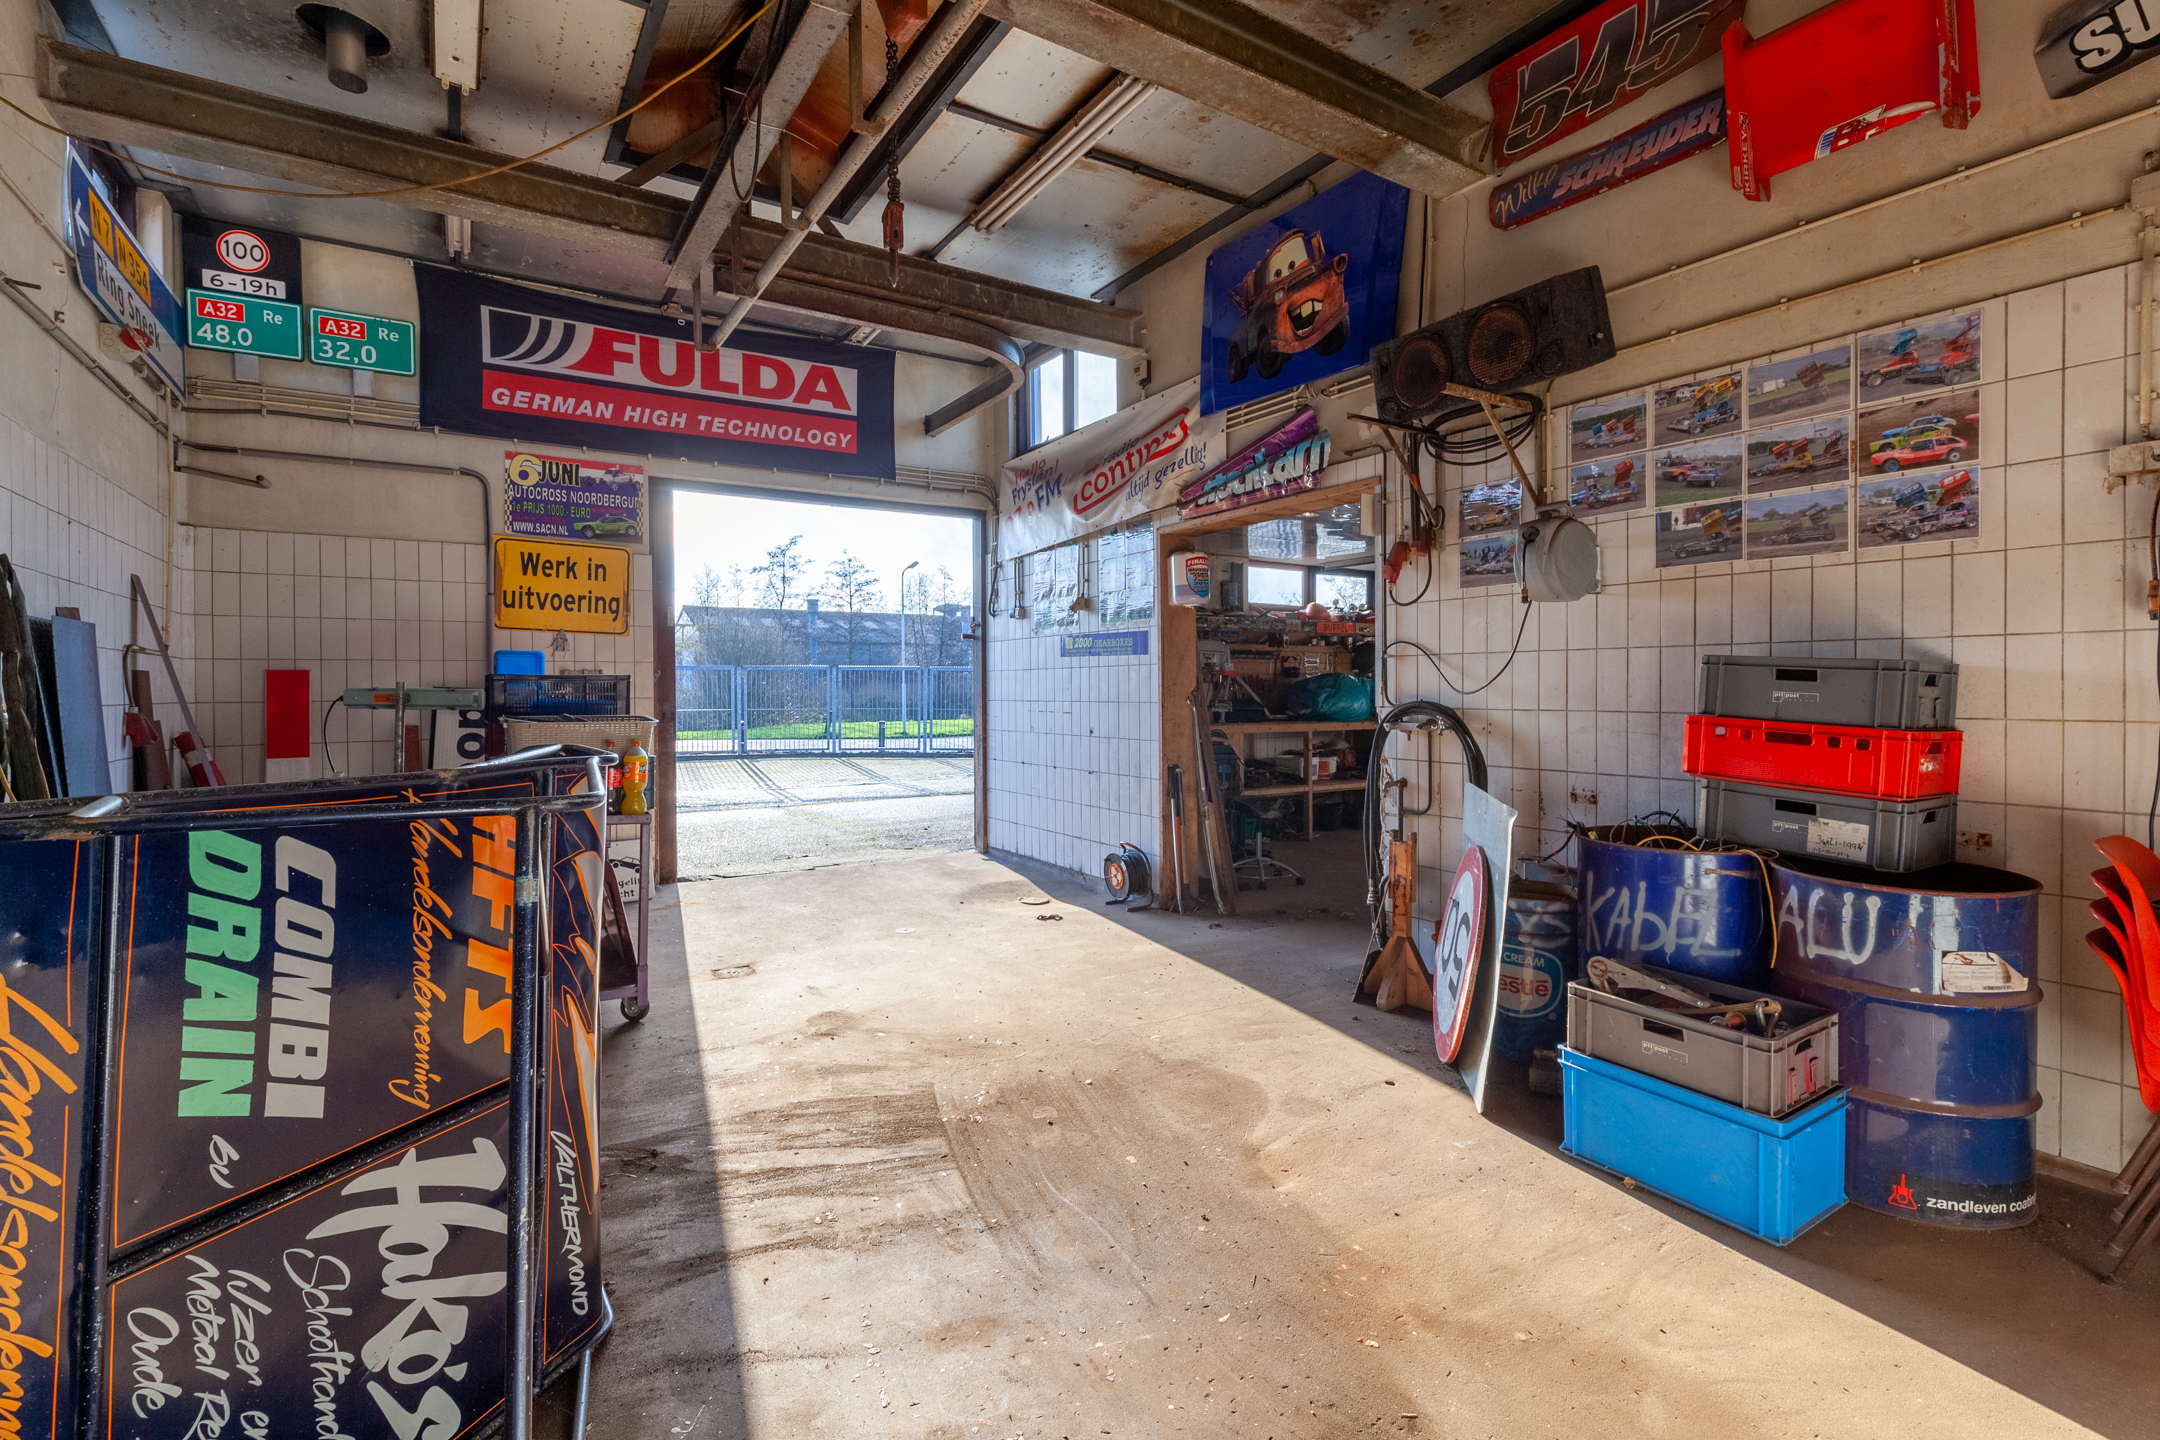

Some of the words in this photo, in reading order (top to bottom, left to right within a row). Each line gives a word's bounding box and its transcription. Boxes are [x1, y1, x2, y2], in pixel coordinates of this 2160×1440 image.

[1504, 0, 1711, 154] 545
[1552, 98, 1724, 199] SCHREUDER
[1741, 131, 1751, 193] KIRKEY
[92, 202, 100, 231] N
[99, 215, 109, 246] 7
[118, 238, 127, 269] N
[129, 253, 150, 296] 354
[223, 239, 264, 263] 100
[97, 250, 124, 317] Ring
[128, 291, 161, 352] Sneek
[210, 274, 277, 296] 6-19h
[203, 302, 237, 319] A32
[263, 310, 283, 325] Re
[325, 320, 361, 337] A32
[378, 328, 399, 342] Re
[197, 323, 253, 346] 48,0
[318, 339, 377, 364] 32,0
[562, 327, 852, 411] FULDA
[491, 387, 613, 420] GERMAN
[623, 404, 688, 430] HIGH
[698, 415, 852, 449] TECHNOLOGY
[1102, 437, 1140, 467] radio
[509, 454, 542, 486] 6
[538, 460, 581, 487] JUNI
[1015, 459, 1046, 486] Hallo
[1125, 471, 1150, 503] altijd
[507, 484, 567, 503] AUTOCROSS
[512, 501, 520, 512] 1e
[523, 502, 545, 514] PRIJS
[570, 506, 591, 519] EURO
[1035, 472, 1063, 513] FM
[513, 521, 569, 536] WWW.SACN.NL
[520, 551, 578, 580] Werk
[587, 557, 607, 582] in
[503, 585, 620, 623] uitvoering
[1074, 637, 1092, 649] 2000
[1093, 638, 1133, 647] GEARBOXES
[1323, 623, 1349, 633] BUFFEL
[1778, 884, 1881, 965] ALU
[388, 788, 463, 1110] Handelsonderneming
[1441, 899, 1472, 1004] 50
[1503, 951, 1545, 968] CREAM
[178, 830, 262, 1117] DRAIN
[264, 835, 337, 1118] COMBI
[550, 1130, 589, 1316] VALTHERMOND
[1926, 1197, 2007, 1214] zandleven
[185, 1254, 231, 1381] Metaal
[127, 1307, 183, 1419] Oude
